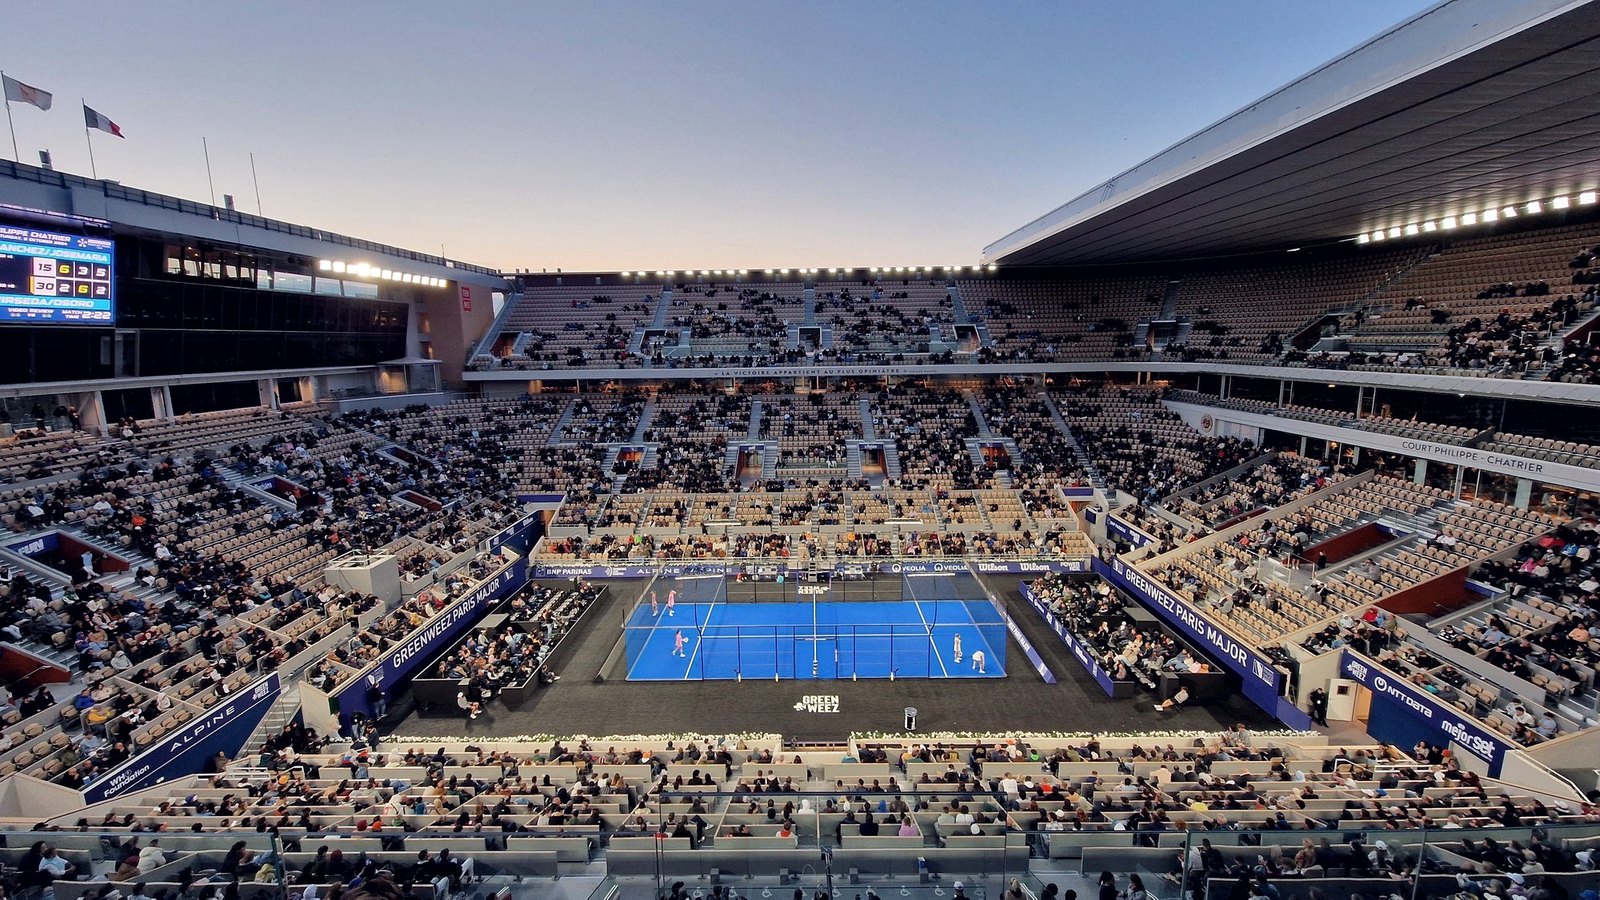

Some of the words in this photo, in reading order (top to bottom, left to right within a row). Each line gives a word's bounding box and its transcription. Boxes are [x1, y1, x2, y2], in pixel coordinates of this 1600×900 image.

[38, 263, 52, 272] 15
[60, 265, 70, 274] 6
[78, 266, 88, 275] 3
[96, 268, 106, 276] 5
[36, 282, 54, 290] 30
[60, 284, 70, 292] 2
[78, 285, 89, 294] 6
[96, 286, 106, 294] 2
[82, 311, 111, 320] 2:22
[1402, 441, 1432, 453] COURT
[1434, 446, 1478, 461] PHILIPPE
[1487, 456, 1543, 472] CHATRIER
[393, 616, 452, 668] GREENWEEZ
[452, 597, 475, 622] PARIS
[476, 578, 500, 603] MAJOR
[1125, 569, 1174, 613] GREENWEEZ
[1176, 605, 1204, 635] PARIS
[1207, 626, 1247, 667] MAJOR
[803, 695, 839, 704] GREEN
[808, 704, 840, 712] WEEZ
[170, 705, 235, 752] ALPINE
[104, 764, 150, 798] Foundation
